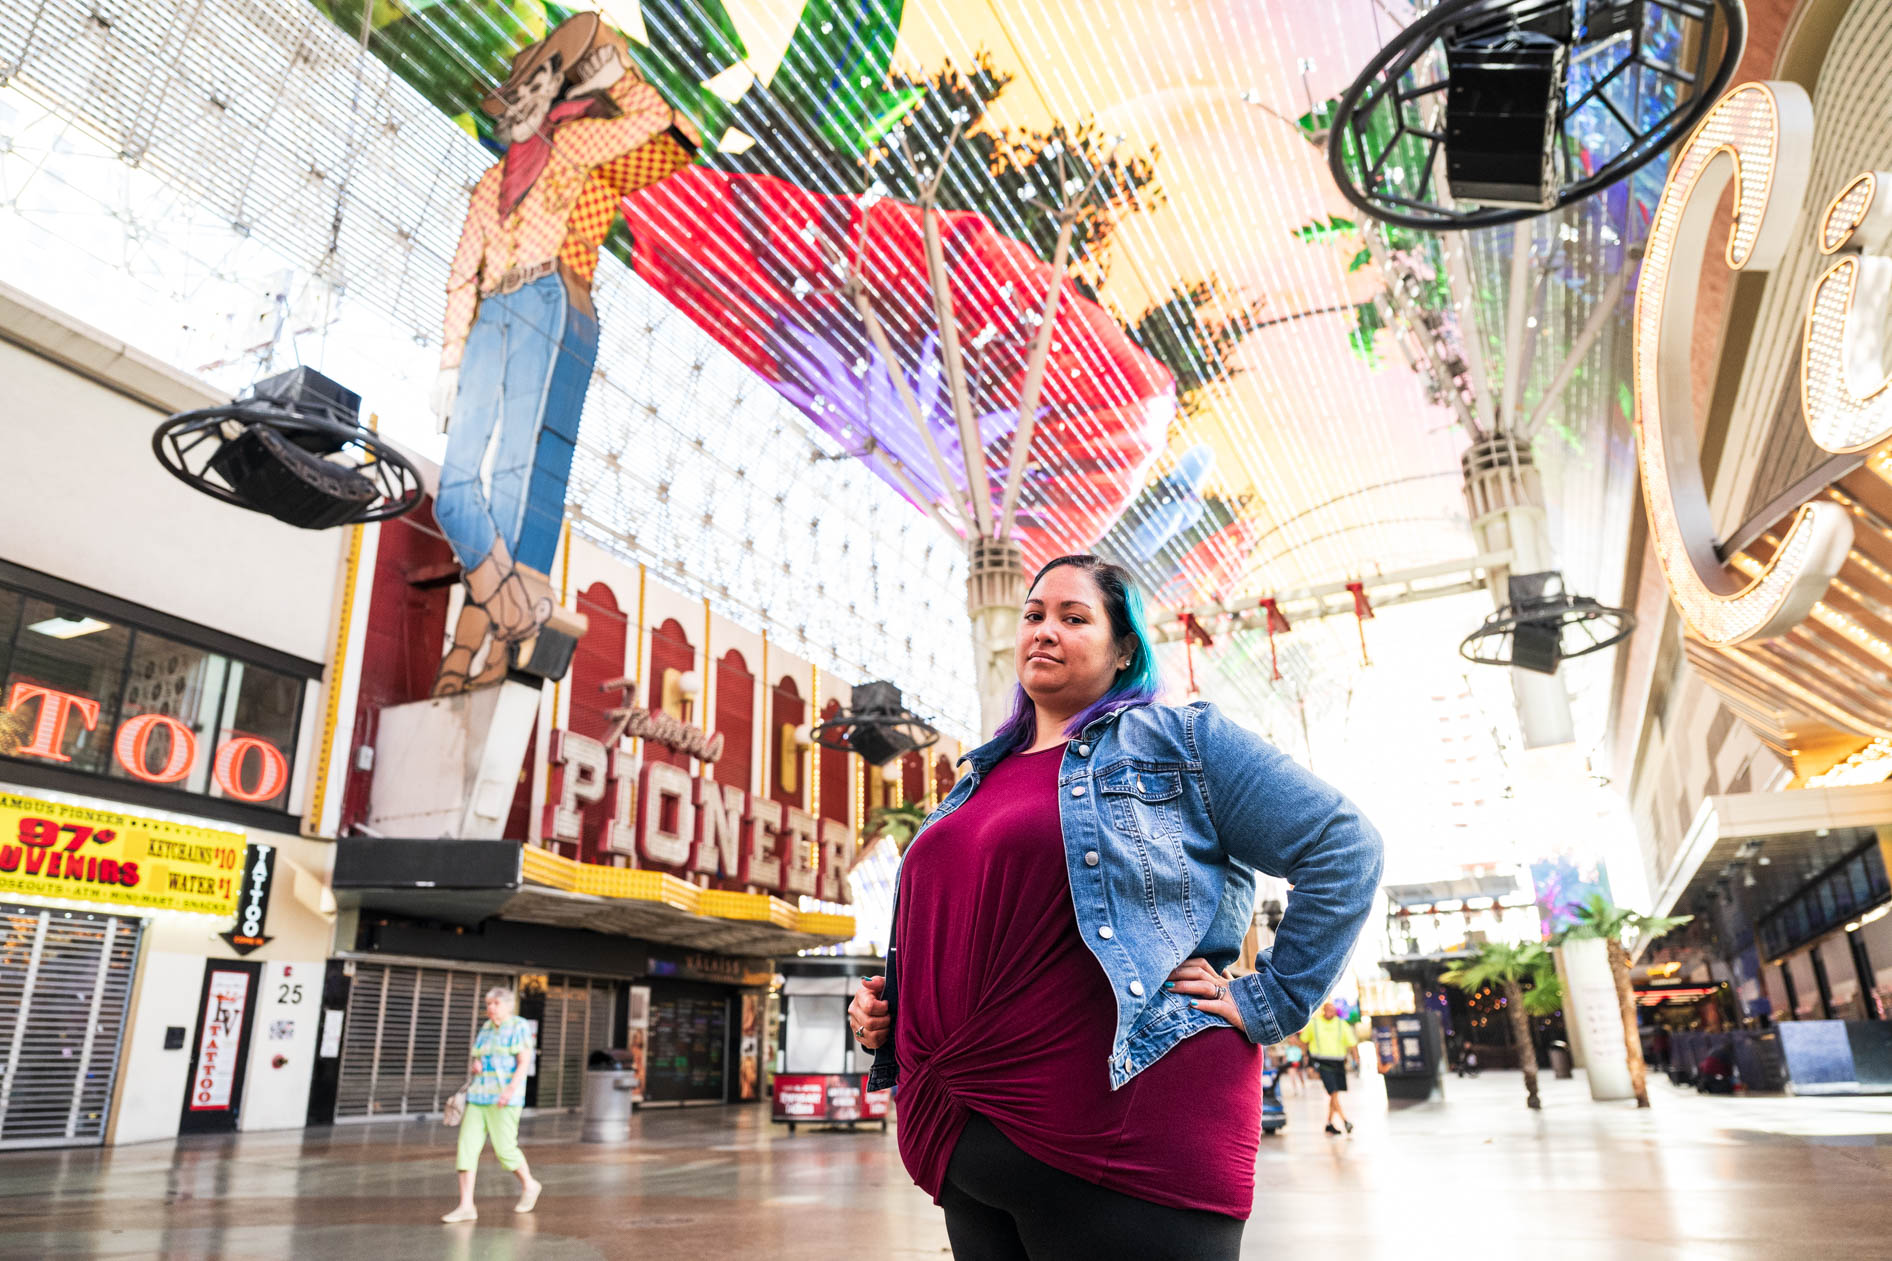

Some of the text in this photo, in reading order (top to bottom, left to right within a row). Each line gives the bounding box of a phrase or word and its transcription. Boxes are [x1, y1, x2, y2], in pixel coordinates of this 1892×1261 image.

[60, 806, 125, 825] PIONEER
[545, 729, 853, 902] PIONEER
[0, 844, 140, 887] UVENIRS
[214, 846, 236, 870] $10
[73, 886, 100, 898] ATM
[168, 871, 231, 900] WATER $1
[242, 844, 271, 937] TATTOO
[277, 984, 303, 1005] 25
[198, 1025, 223, 1104] TATTOO
